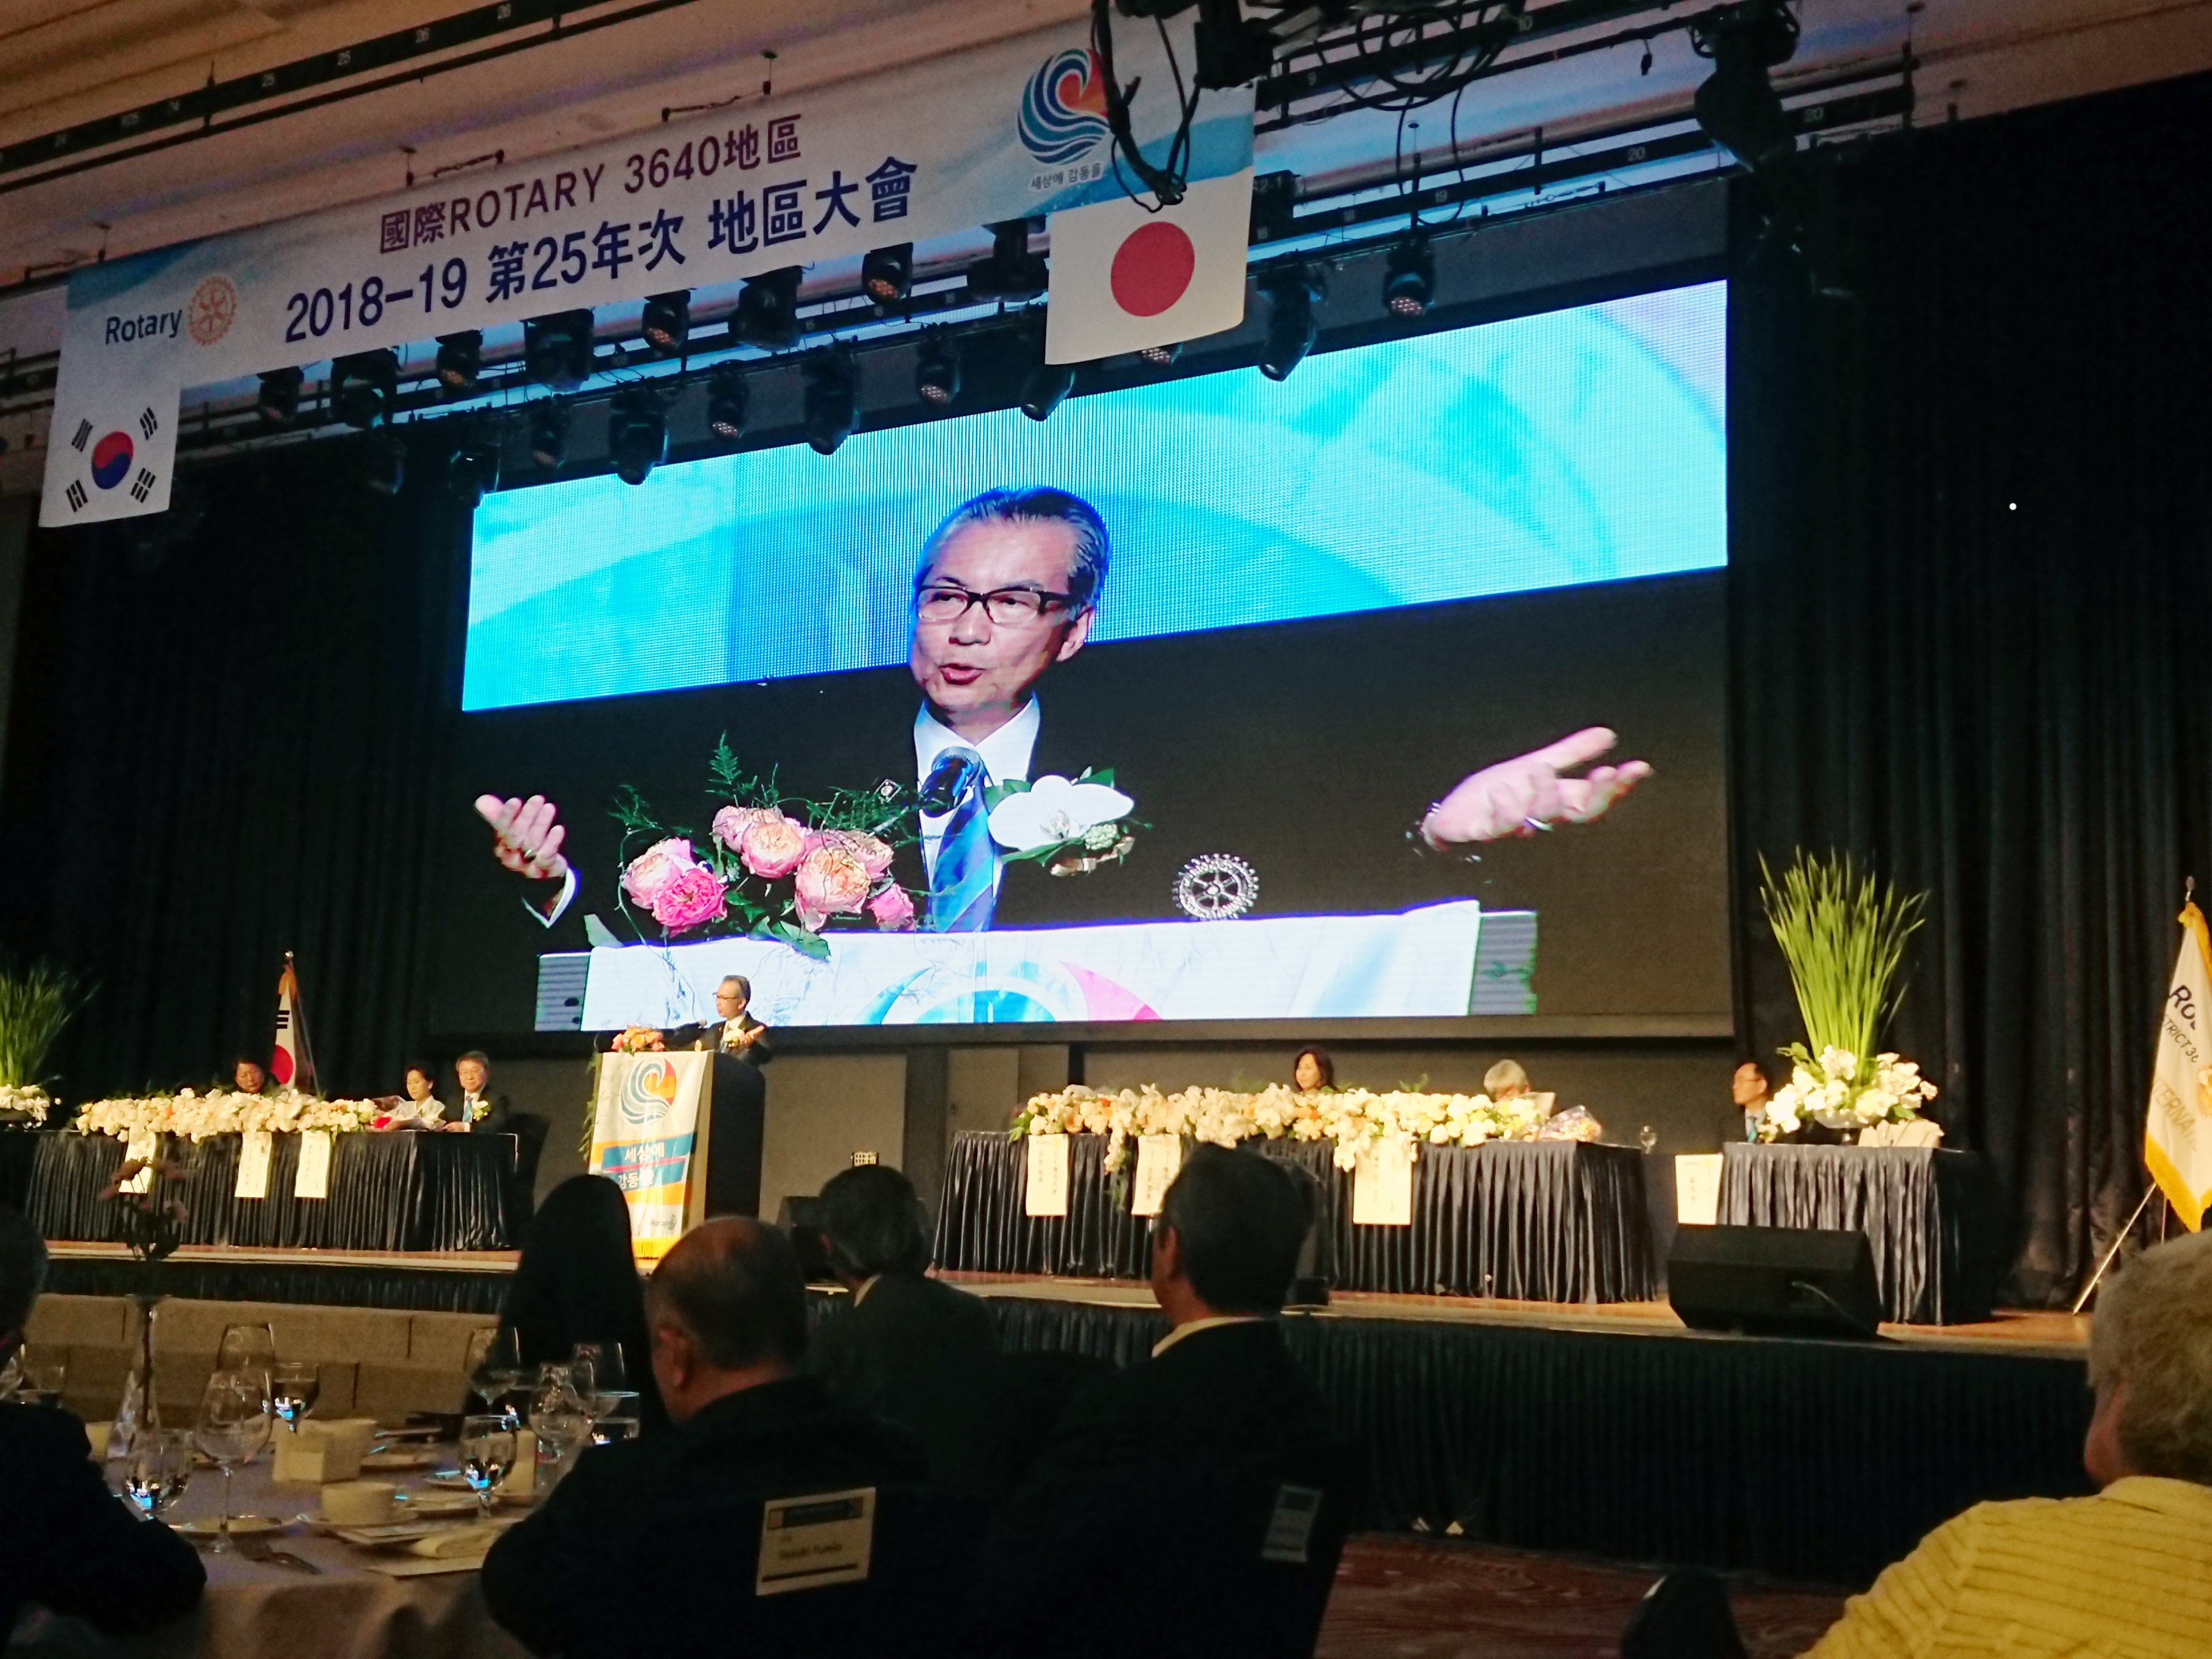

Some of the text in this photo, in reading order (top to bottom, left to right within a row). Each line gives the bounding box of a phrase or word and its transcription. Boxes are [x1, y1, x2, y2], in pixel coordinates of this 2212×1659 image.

[1627, 146, 1646, 162] 20
[380, 113, 801, 254] 國際ROTARY 3640地區
[1030, 171, 1064, 190] 세상에
[285, 156, 917, 343] 2018-19 第25年次 地區大會
[105, 309, 183, 345] Rotary
[624, 1141, 665, 1163] 세상에
